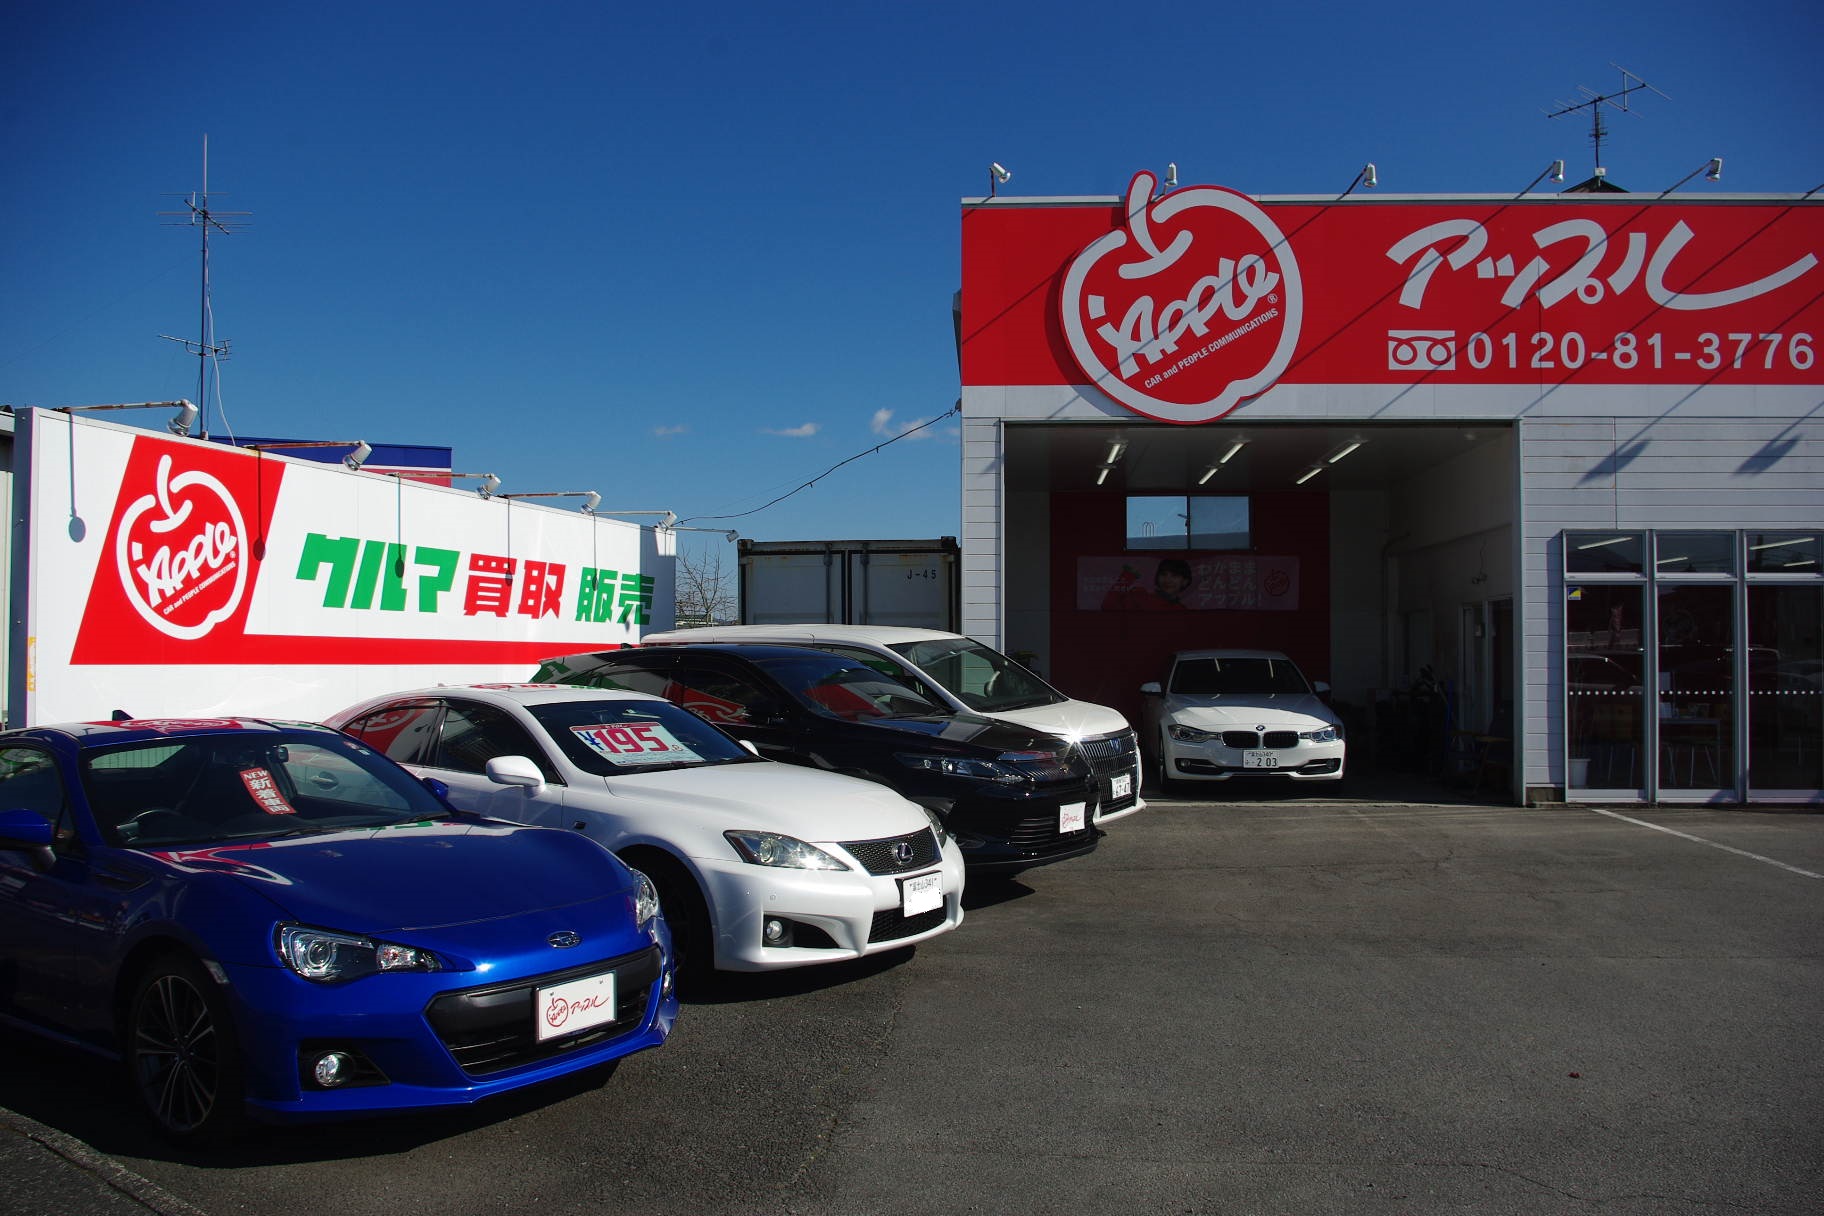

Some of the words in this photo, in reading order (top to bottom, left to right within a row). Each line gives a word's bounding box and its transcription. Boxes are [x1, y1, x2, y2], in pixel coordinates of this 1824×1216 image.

[1385, 218, 1819, 311] アップル
[1088, 253, 1280, 381] Apple
[1144, 373, 1163, 389] CAR
[1163, 365, 1178, 380] and
[1178, 348, 1209, 371] PEOPLE
[1208, 307, 1279, 353] COMMUNICATIONS
[1467, 331, 1815, 370] 0120-81-3776
[132, 521, 237, 608] Apple
[906, 569, 937, 580] J-45
[243, 770, 269, 780] NEW
